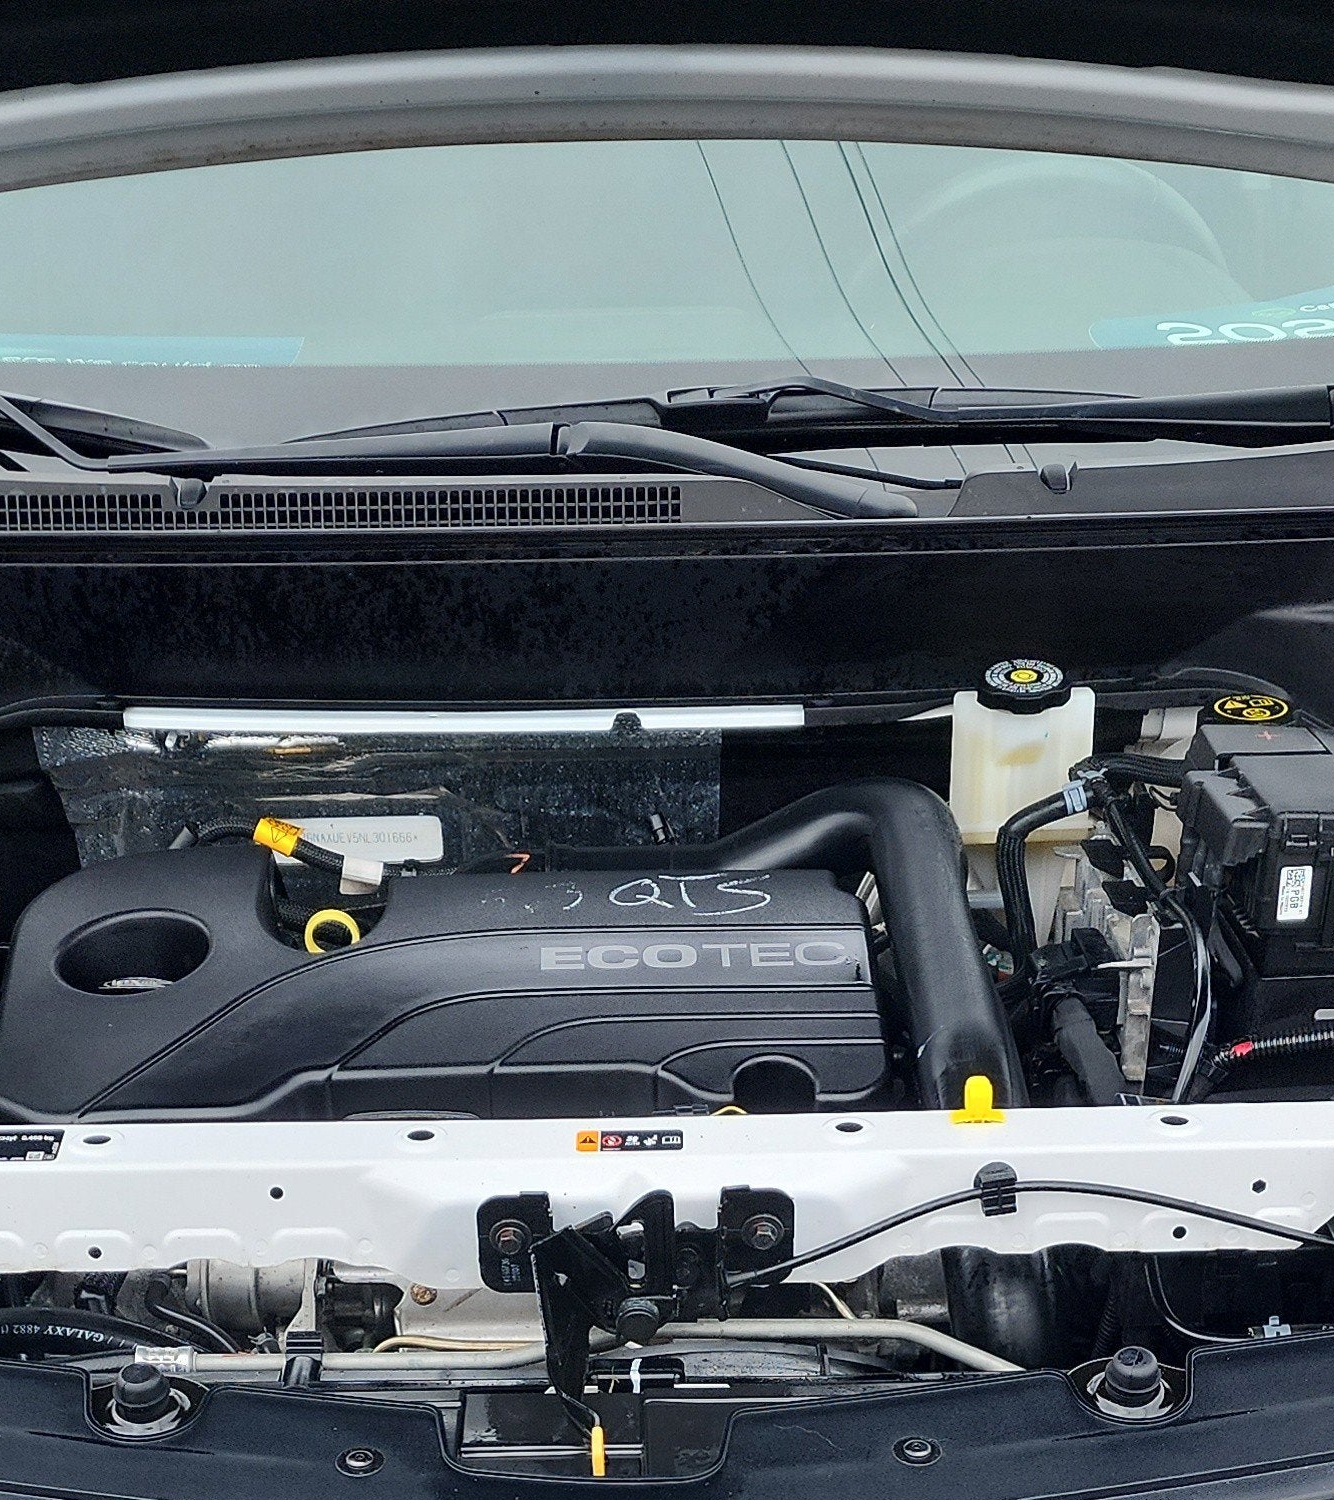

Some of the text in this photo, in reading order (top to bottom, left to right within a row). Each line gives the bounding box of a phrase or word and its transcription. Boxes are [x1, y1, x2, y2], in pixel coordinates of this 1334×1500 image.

[540, 940, 850, 971] ECOTEC
[12, 1324, 41, 1335] 4882
[43, 1325, 105, 1343] GALAXY
